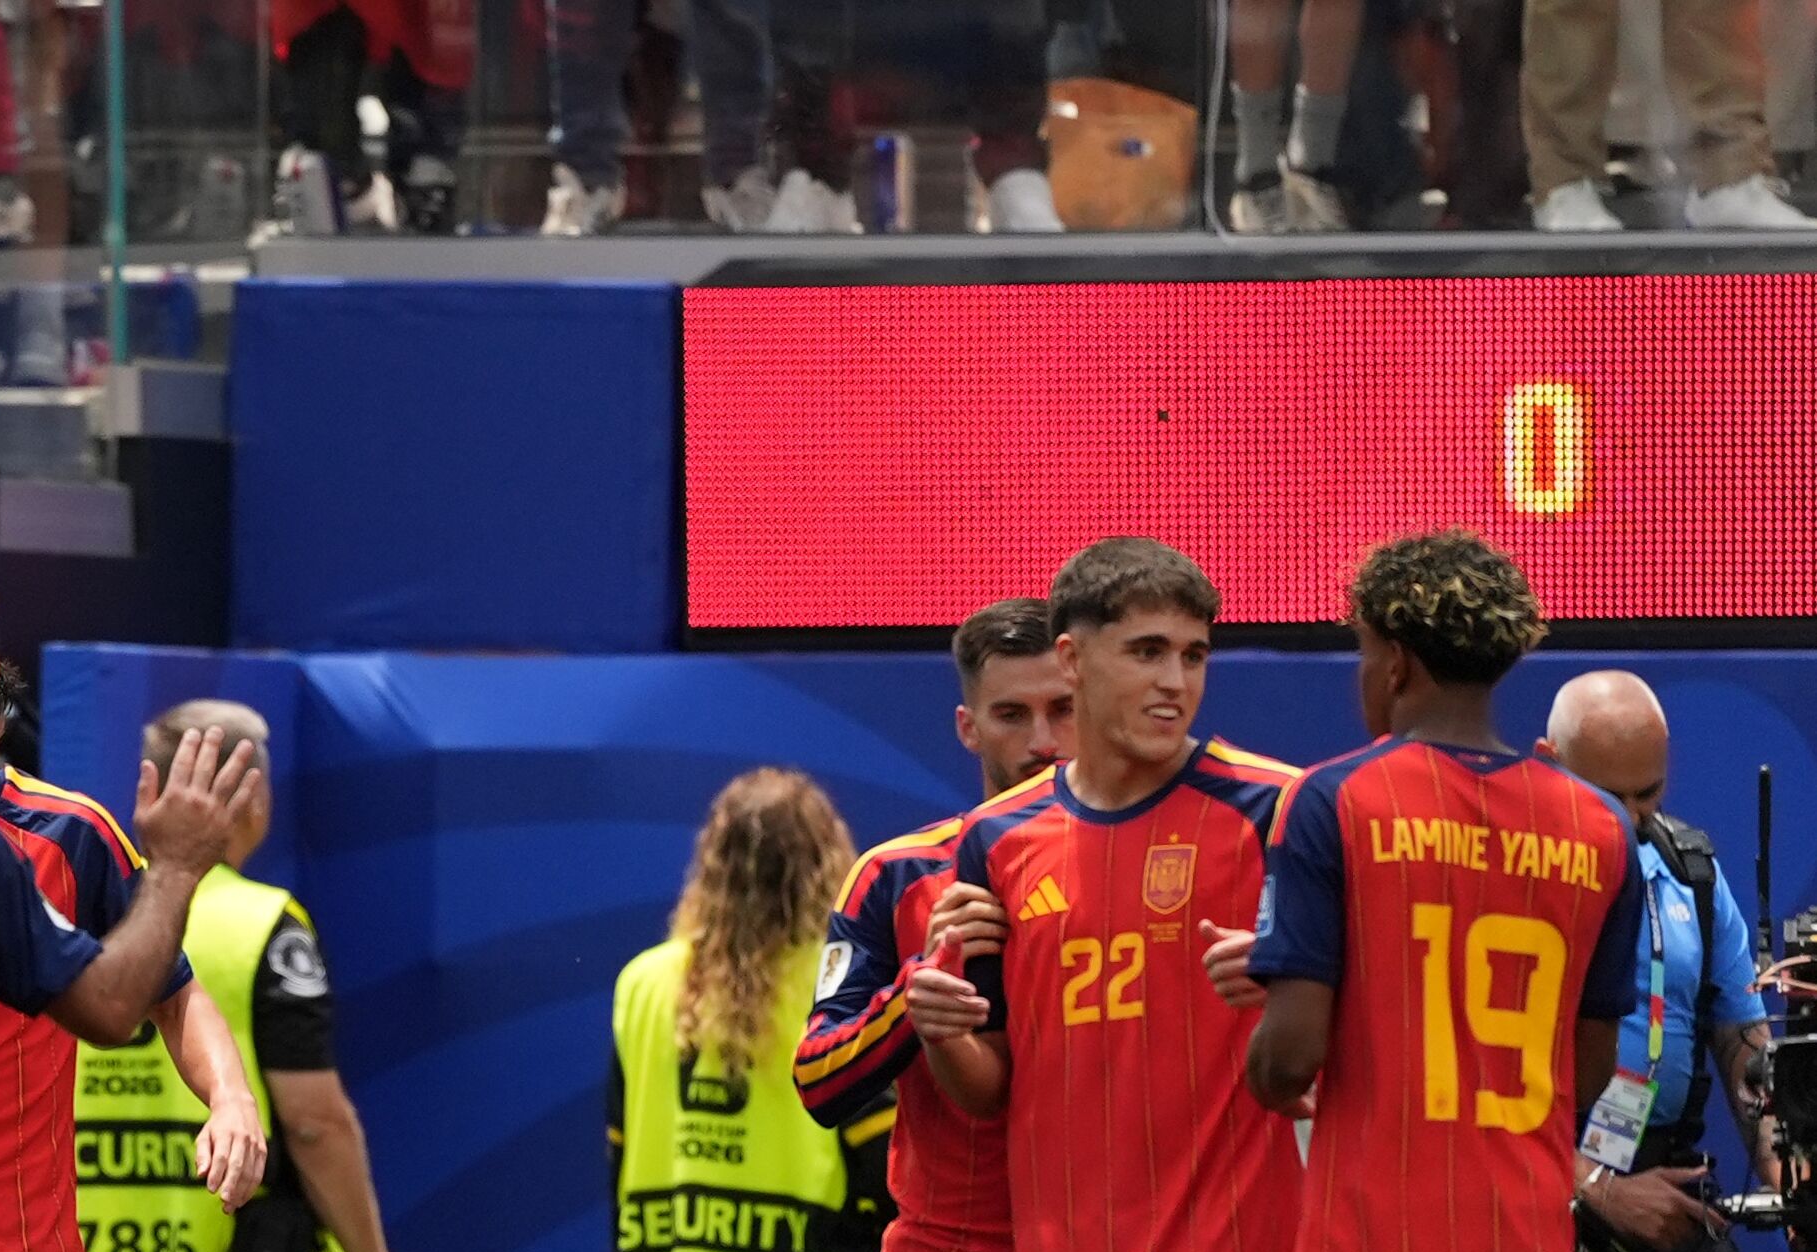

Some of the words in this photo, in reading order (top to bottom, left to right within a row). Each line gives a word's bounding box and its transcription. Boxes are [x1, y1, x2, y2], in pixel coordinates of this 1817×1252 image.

[1504, 384, 1583, 512] 0
[1370, 817, 1490, 872] LAMINE
[1500, 829, 1602, 893] YAMAL
[1061, 931, 1145, 1027] 22
[1411, 902, 1567, 1134] 19
[679, 1138, 745, 1165] 026
